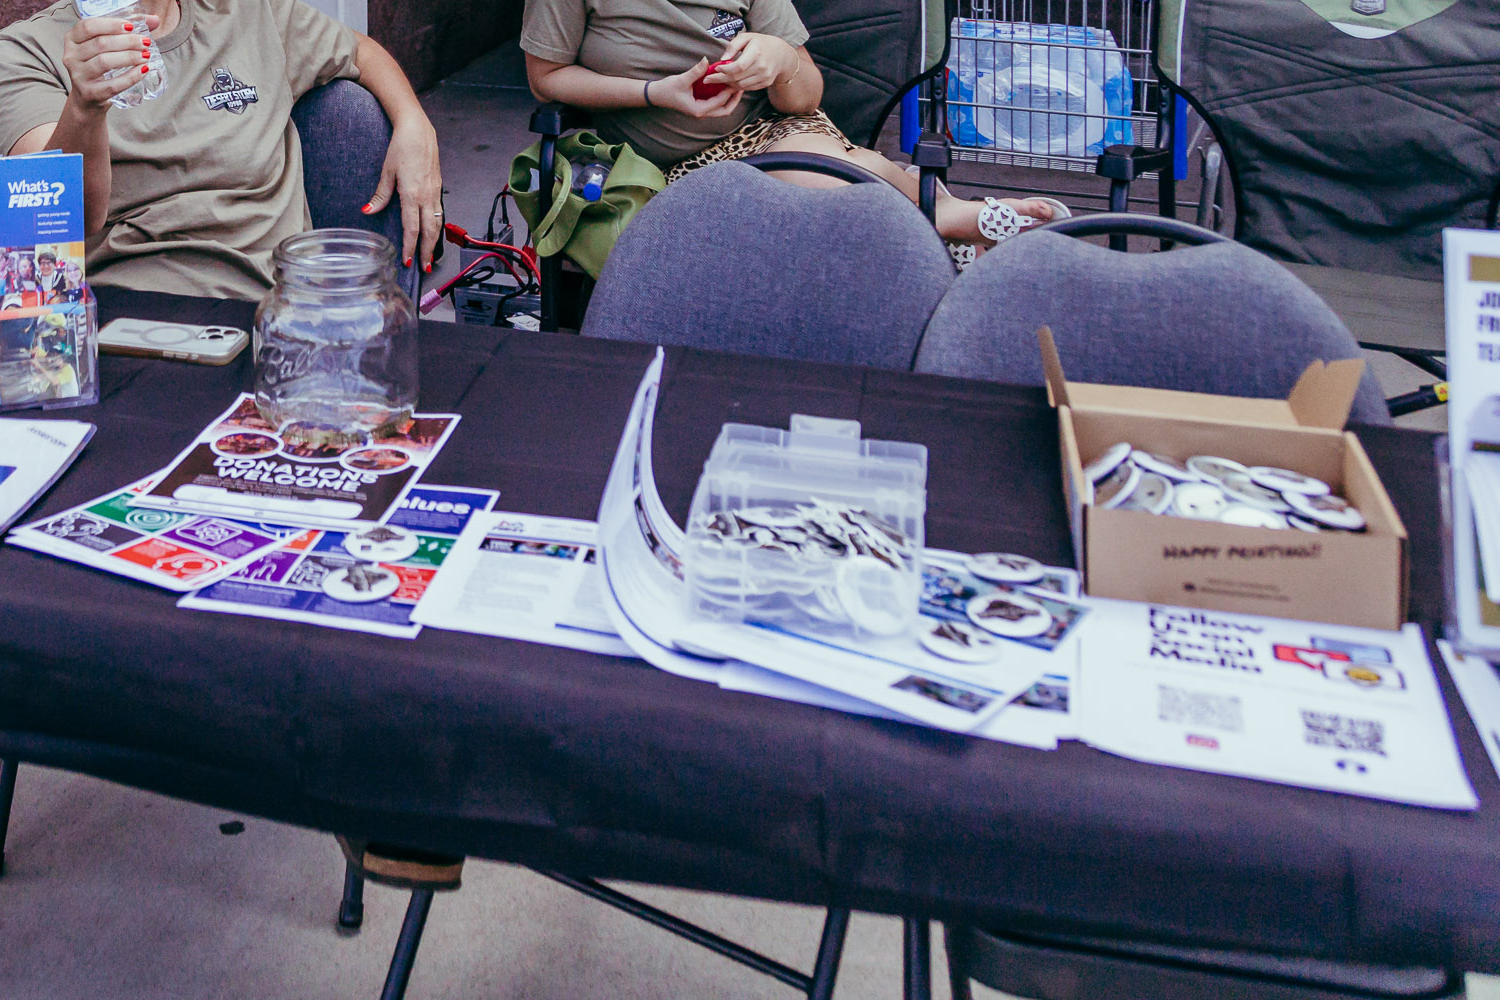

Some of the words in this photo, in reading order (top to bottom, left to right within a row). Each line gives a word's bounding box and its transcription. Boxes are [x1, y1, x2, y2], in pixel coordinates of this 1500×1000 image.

[204, 91, 233, 109] DESERT
[232, 87, 258, 101] STORM
[7, 179, 49, 194] What's
[213, 456, 379, 485] DONATIONS
[218, 466, 362, 493] WELCOME
[397, 496, 471, 515] alues
[1149, 608, 1264, 635] Follow
[1149, 619, 1189, 635] Us
[1149, 632, 1254, 659] Social
[1149, 645, 1263, 673] Media
